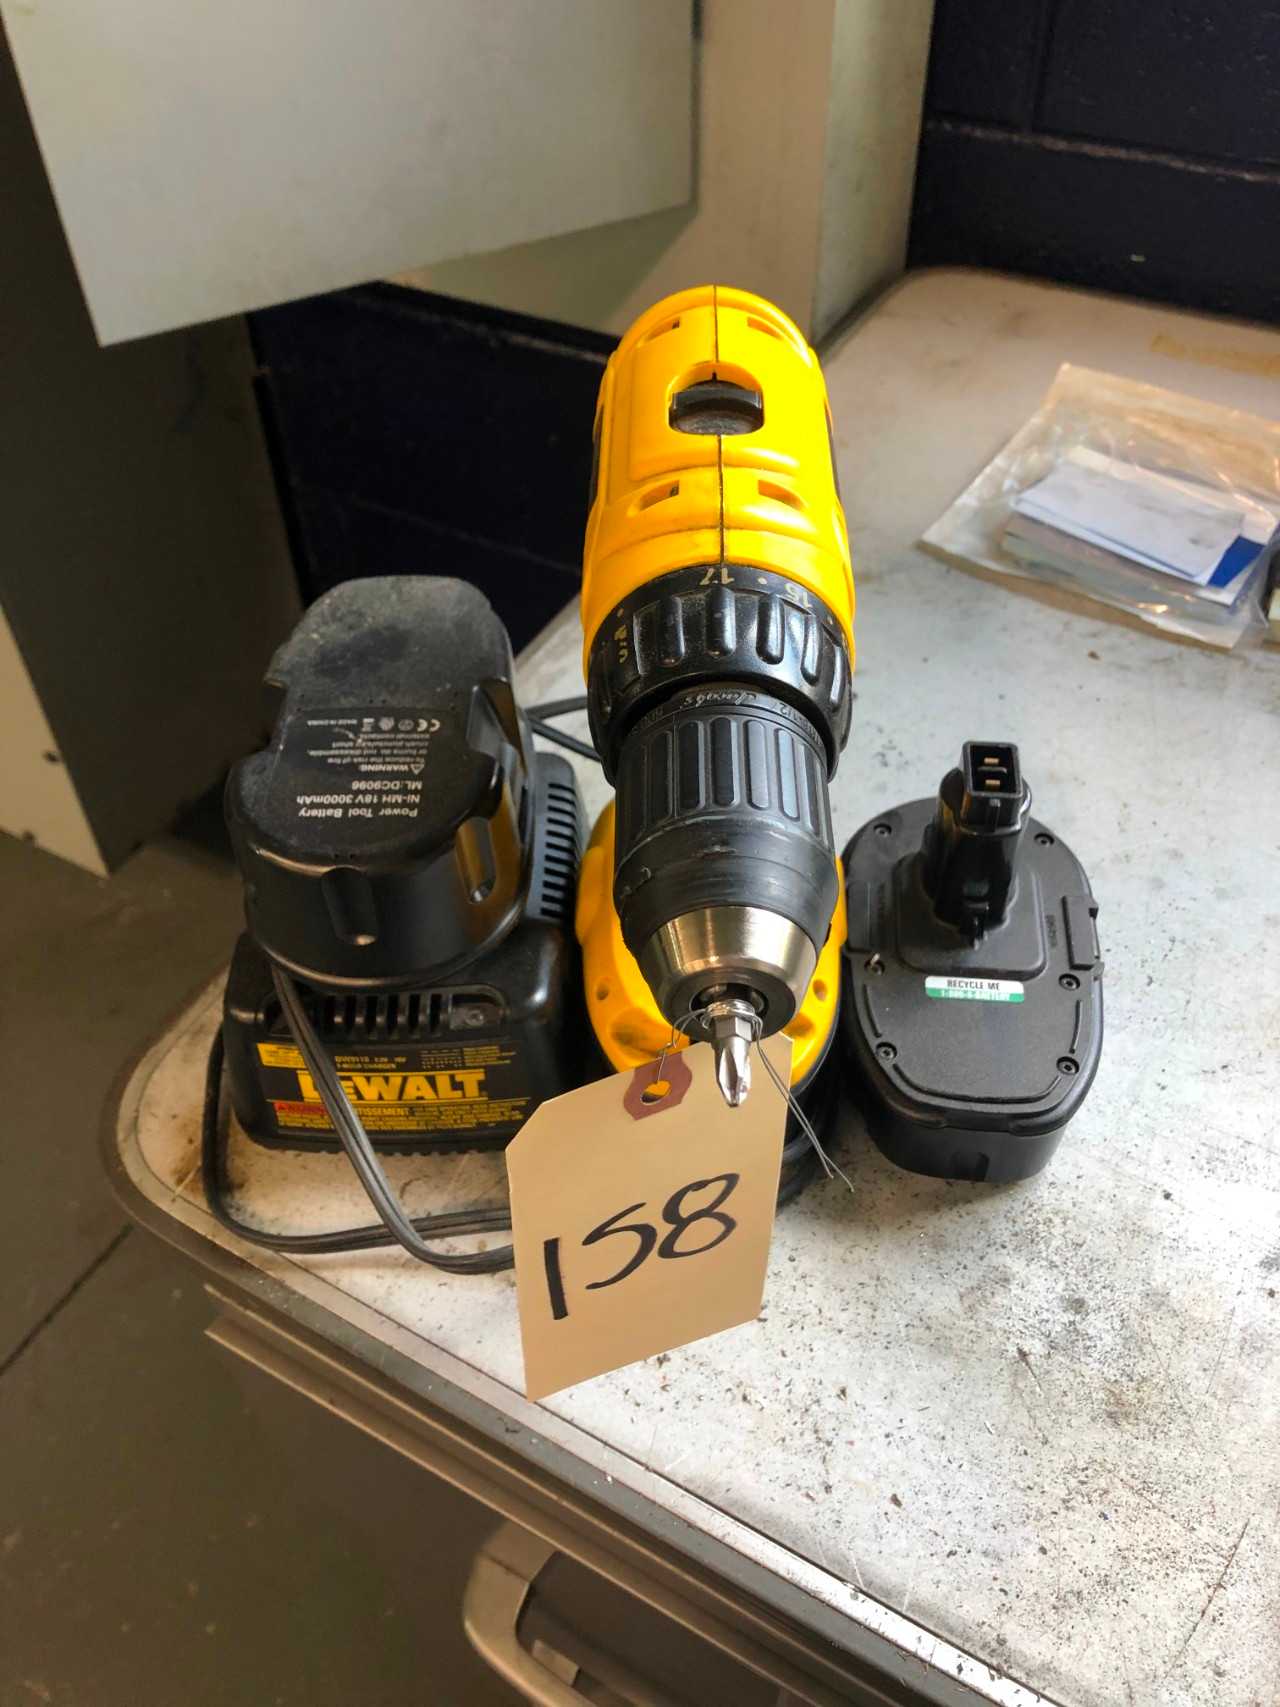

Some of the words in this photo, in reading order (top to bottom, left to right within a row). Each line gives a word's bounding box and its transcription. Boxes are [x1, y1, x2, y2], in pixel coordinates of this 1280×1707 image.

[700, 568, 735, 585] 17
[785, 582, 813, 609] 15
[296, 795, 354, 805] 3000mAh
[356, 795, 378, 804] 18V
[382, 795, 420, 803] Ni-MH
[298, 808, 343, 818] Battery
[348, 808, 374, 817] Tool
[379, 808, 418, 817] Power
[946, 979, 984, 990] RECYCLE
[987, 982, 1000, 991] ME
[543, 1172, 741, 1321] 158
